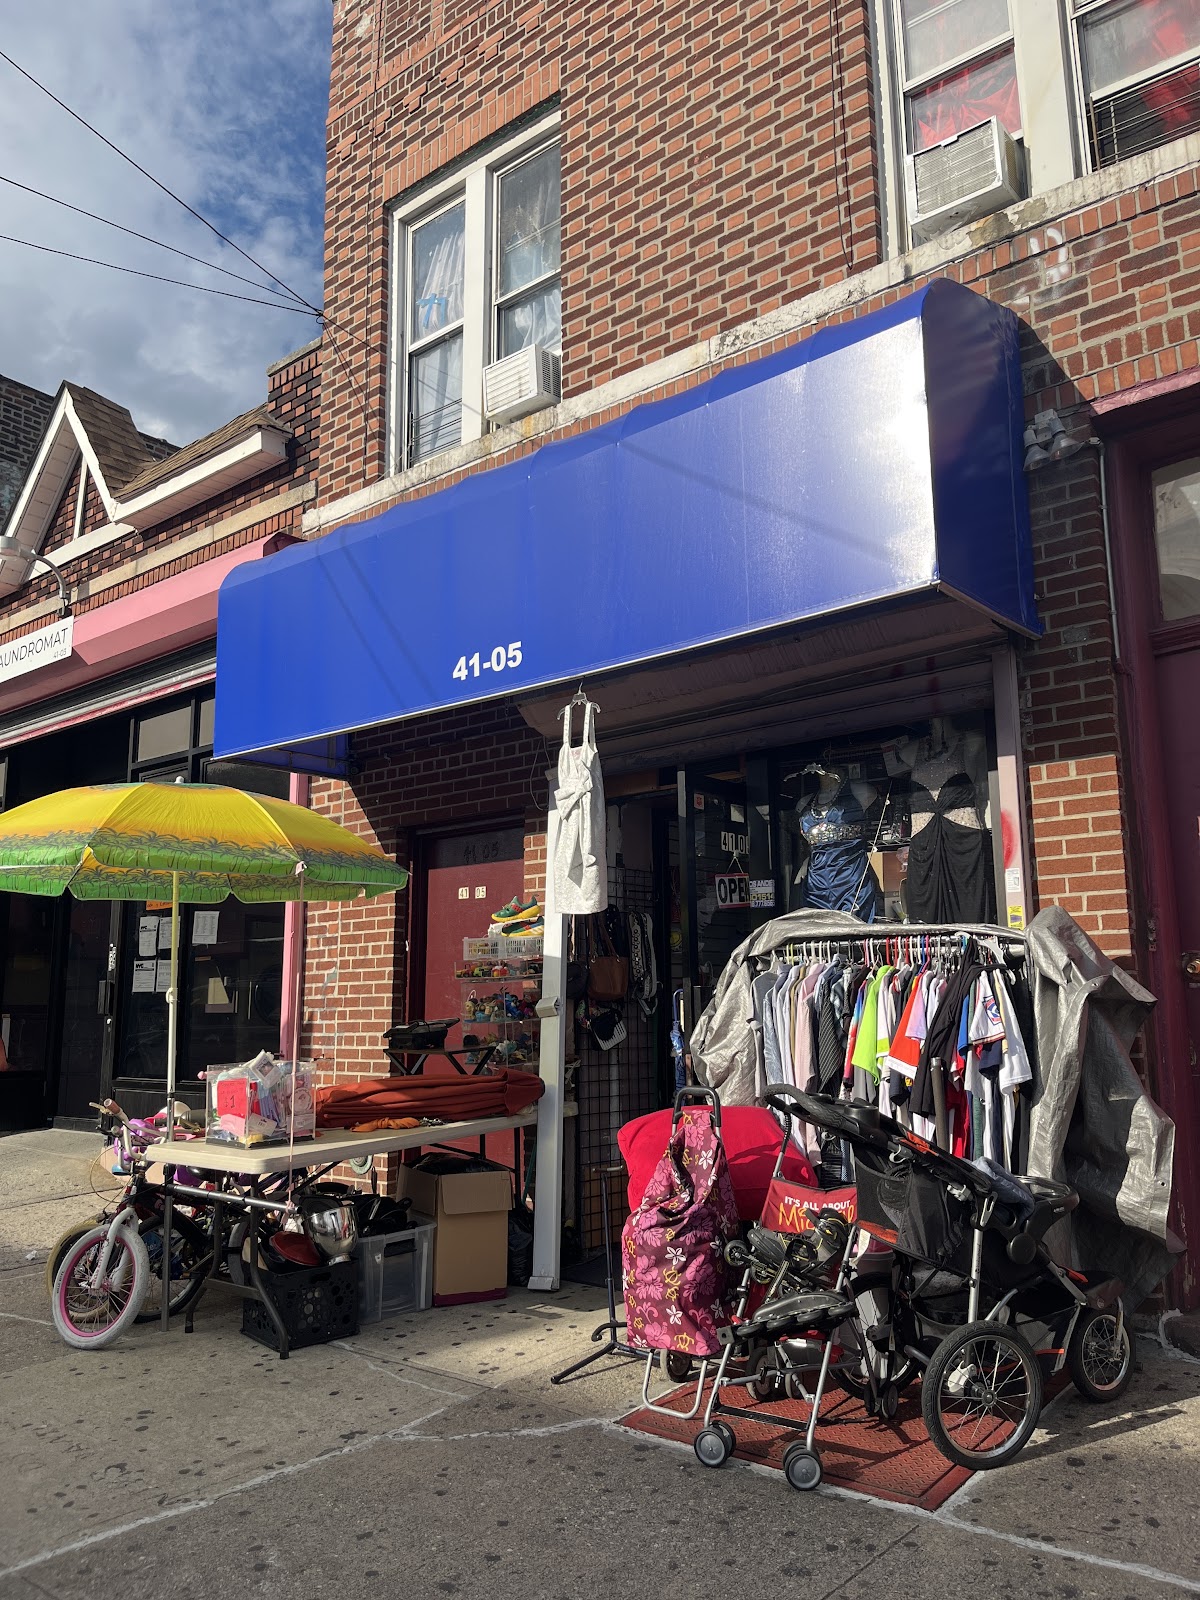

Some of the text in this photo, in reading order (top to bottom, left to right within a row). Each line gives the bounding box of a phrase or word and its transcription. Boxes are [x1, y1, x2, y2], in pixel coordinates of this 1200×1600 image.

[452, 640, 523, 681] 41-05
[459, 887, 485, 898] 41 05
[784, 1195, 800, 1207] IT'S
[802, 1201, 819, 1211] ALL
